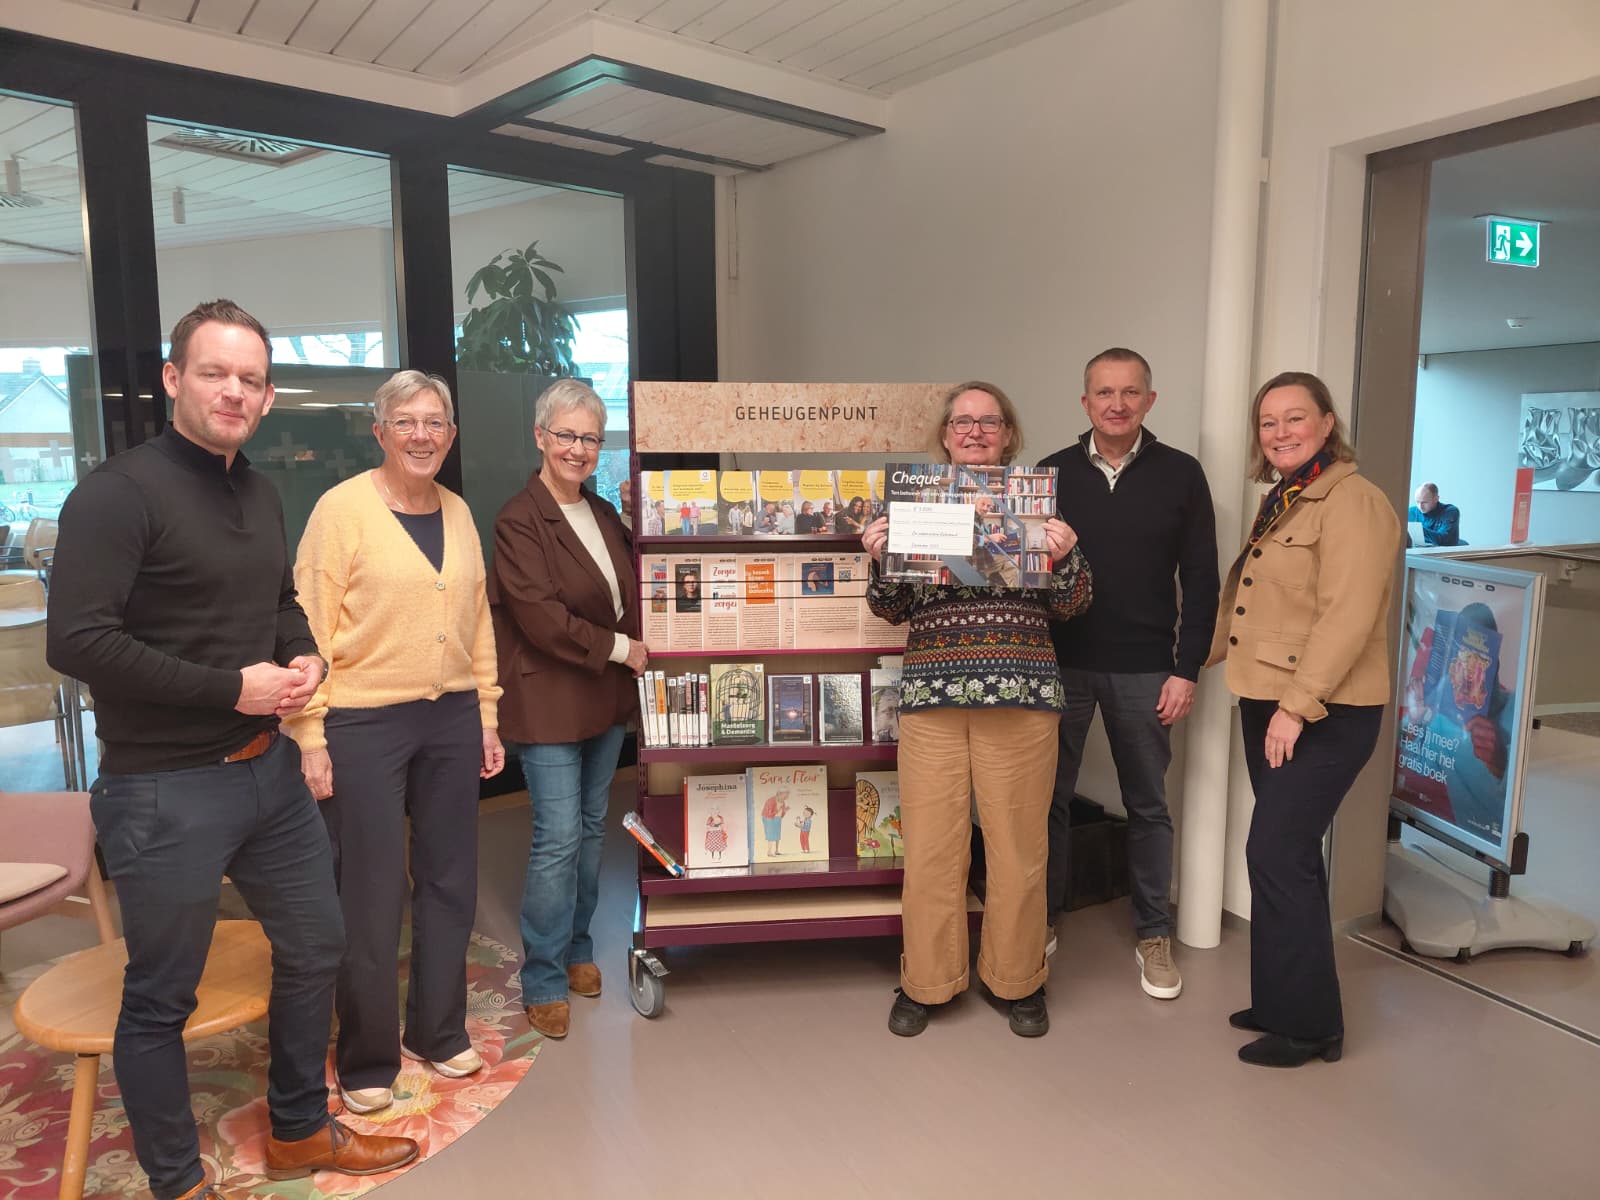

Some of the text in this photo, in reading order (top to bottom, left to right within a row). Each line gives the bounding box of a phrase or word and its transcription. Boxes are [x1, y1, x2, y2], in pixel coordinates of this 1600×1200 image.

[735, 406, 878, 421] GEHEUGENPUNT
[891, 471, 941, 488] Cheque
[1402, 722, 1425, 738] Lees
[1432, 732, 1460, 753] mee?
[1400, 735, 1456, 771] Haal hier het
[760, 771, 783, 784] Sara
[1398, 754, 1448, 785] gratis boek
[696, 783, 738, 793] Josephina
